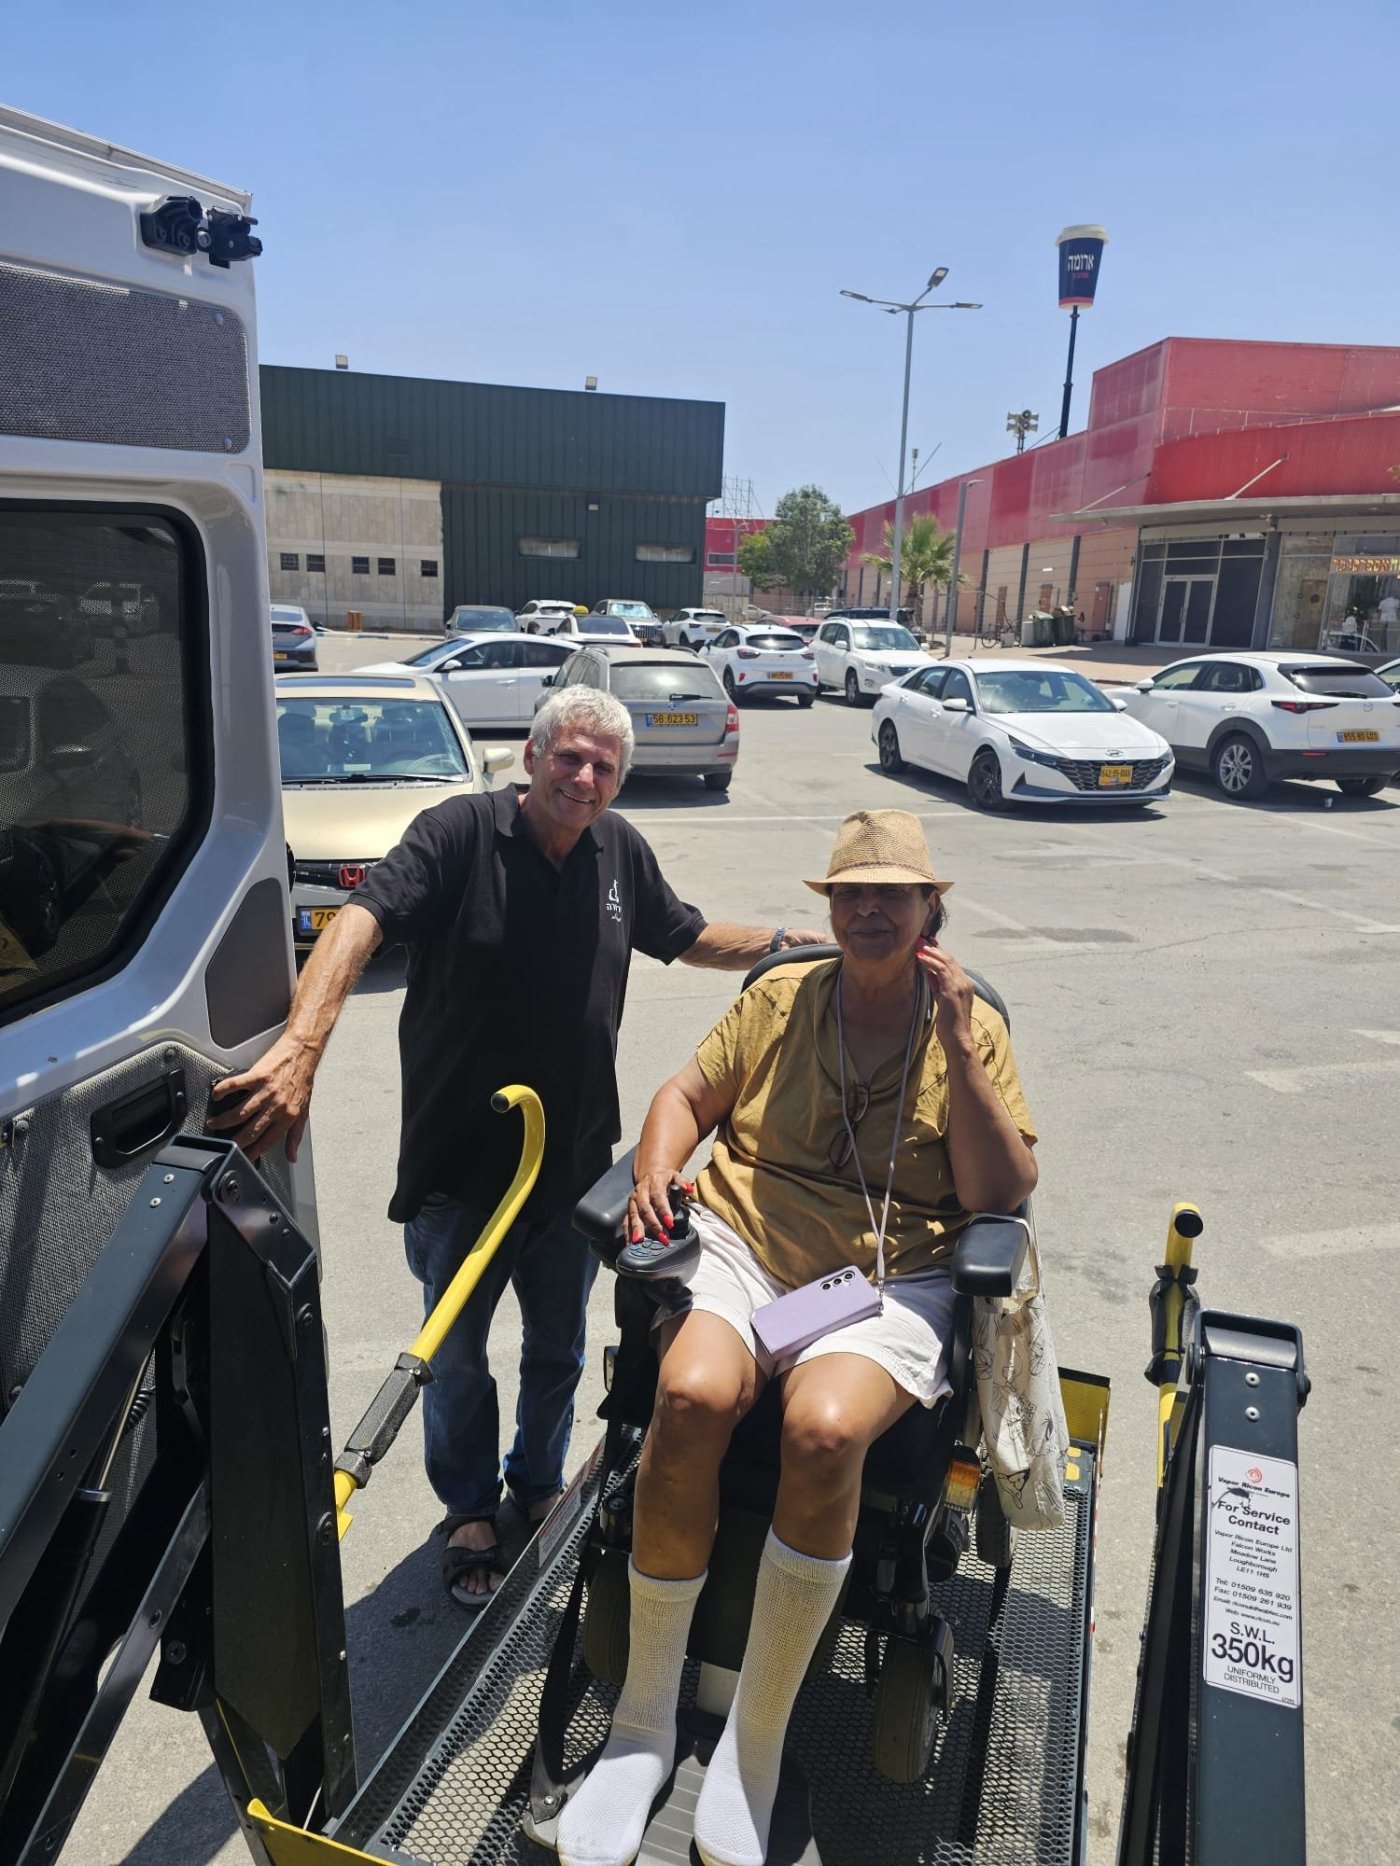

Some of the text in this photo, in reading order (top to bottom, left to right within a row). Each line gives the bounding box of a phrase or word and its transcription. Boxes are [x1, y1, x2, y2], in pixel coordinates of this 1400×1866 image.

[1067, 253, 1094, 272] ארומה
[1264, 1487, 1290, 1499] Europe
[1218, 1500, 1291, 1525] For Service
[1228, 1515, 1280, 1535] Contact
[1214, 1529, 1233, 1539] Vapor
[1255, 1539, 1280, 1550] Europe
[1280, 1545, 1293, 1553] Ltd
[1231, 1540, 1276, 1556] Falcon Works
[1229, 1555, 1278, 1573] Loughborough
[1230, 1548, 1277, 1564] Meadow Lane
[1236, 1565, 1254, 1574] LE11
[1214, 1586, 1230, 1595] Fax:
[1232, 1590, 1257, 1601] 01509
[1216, 1577, 1229, 1586] Tel:
[1231, 1581, 1256, 1593] 01509
[1275, 1592, 1291, 1601] 920
[1230, 1621, 1275, 1645] S.W.L.
[1211, 1633, 1294, 1683] 350kg
[1223, 1673, 1280, 1694] DISTRIBUTED
[1227, 1665, 1277, 1685] UNIFORMLY
